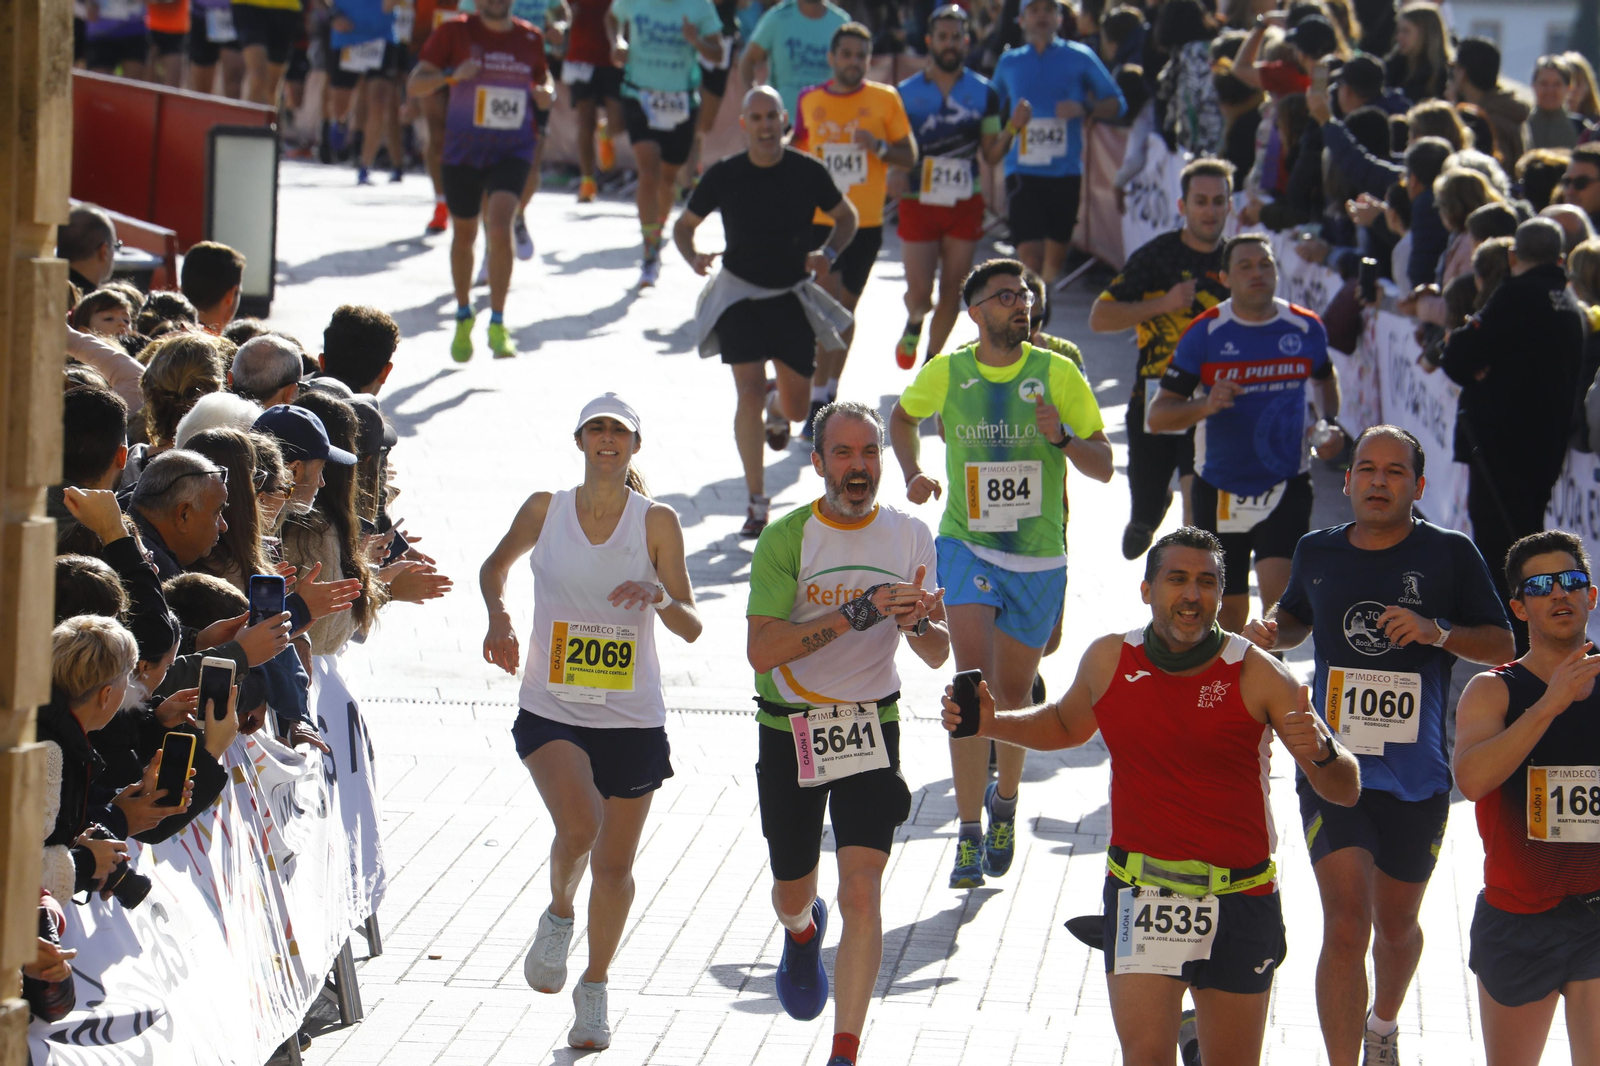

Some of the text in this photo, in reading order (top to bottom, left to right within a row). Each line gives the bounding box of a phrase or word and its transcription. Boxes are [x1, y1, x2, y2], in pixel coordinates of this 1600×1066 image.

[490, 98, 518, 117] 904
[1028, 126, 1064, 145] 2042
[826, 153, 862, 171] 1041
[933, 166, 969, 184] 2141
[1245, 363, 1306, 378] PUEBLA
[987, 465, 1017, 473] IMDECO
[987, 477, 1031, 501] 884
[579, 624, 614, 635] IMDECO
[566, 638, 632, 668] 2069
[1355, 639, 1372, 647] Rock
[1373, 641, 1386, 649] and
[554, 644, 562, 670] CAJÓN
[1355, 673, 1391, 683] IMDECO
[1330, 693, 1338, 720] CAJÓN
[1344, 686, 1414, 719] 1060
[817, 708, 852, 720] IMDCO
[813, 721, 876, 756] 5641
[801, 738, 810, 765] CAJÓN
[835, 753, 853, 761] PUERMA
[1560, 769, 1597, 778] IMDECO
[1534, 794, 1542, 823] CAJÓN
[1146, 889, 1184, 899] IMCO
[1122, 914, 1130, 942] CAJÓN
[1134, 904, 1213, 936] 4535
